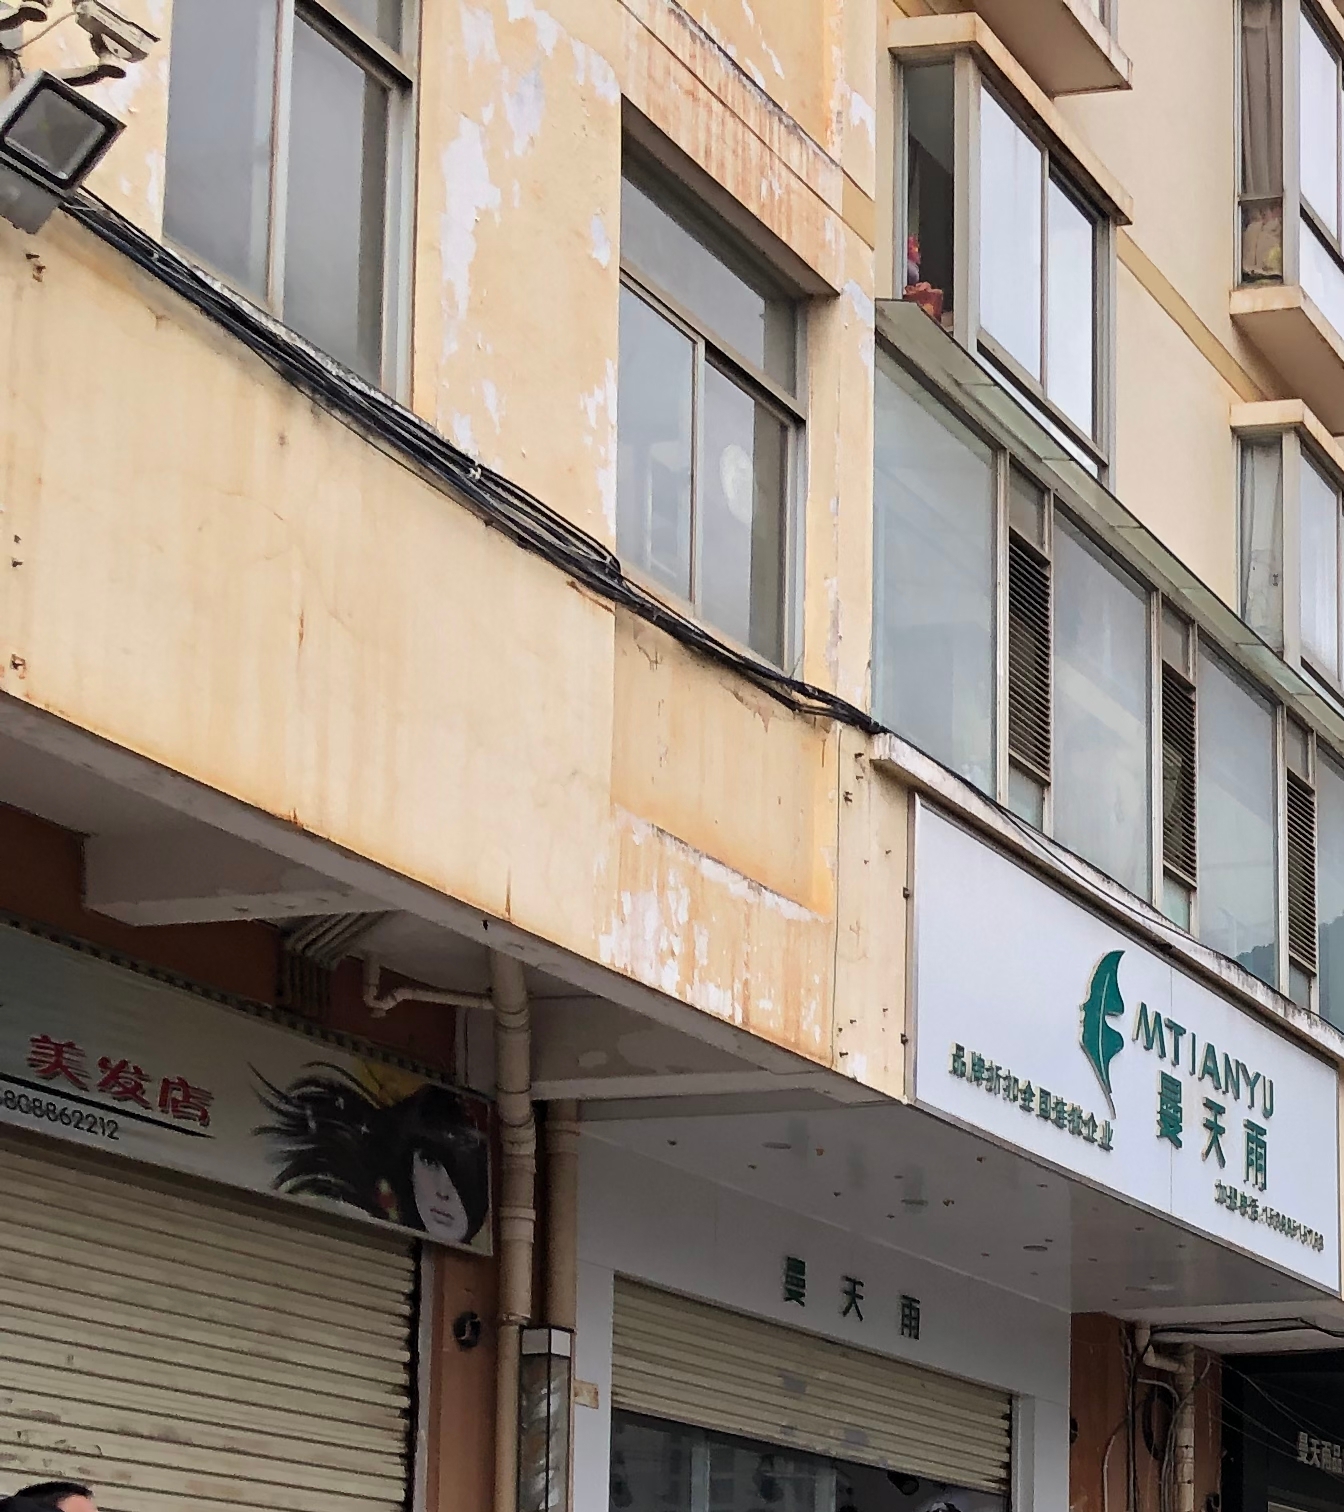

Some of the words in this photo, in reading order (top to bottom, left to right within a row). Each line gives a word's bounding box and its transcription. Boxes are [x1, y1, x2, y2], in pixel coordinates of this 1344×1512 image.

[27, 1034, 215, 1128] 美发店
[1133, 1001, 1275, 1119] MTIANYU
[0, 1088, 120, 1141] 808862212
[1156, 1070, 1268, 1192] 曼天雨
[784, 1255, 922, 1341] 曼天雨
